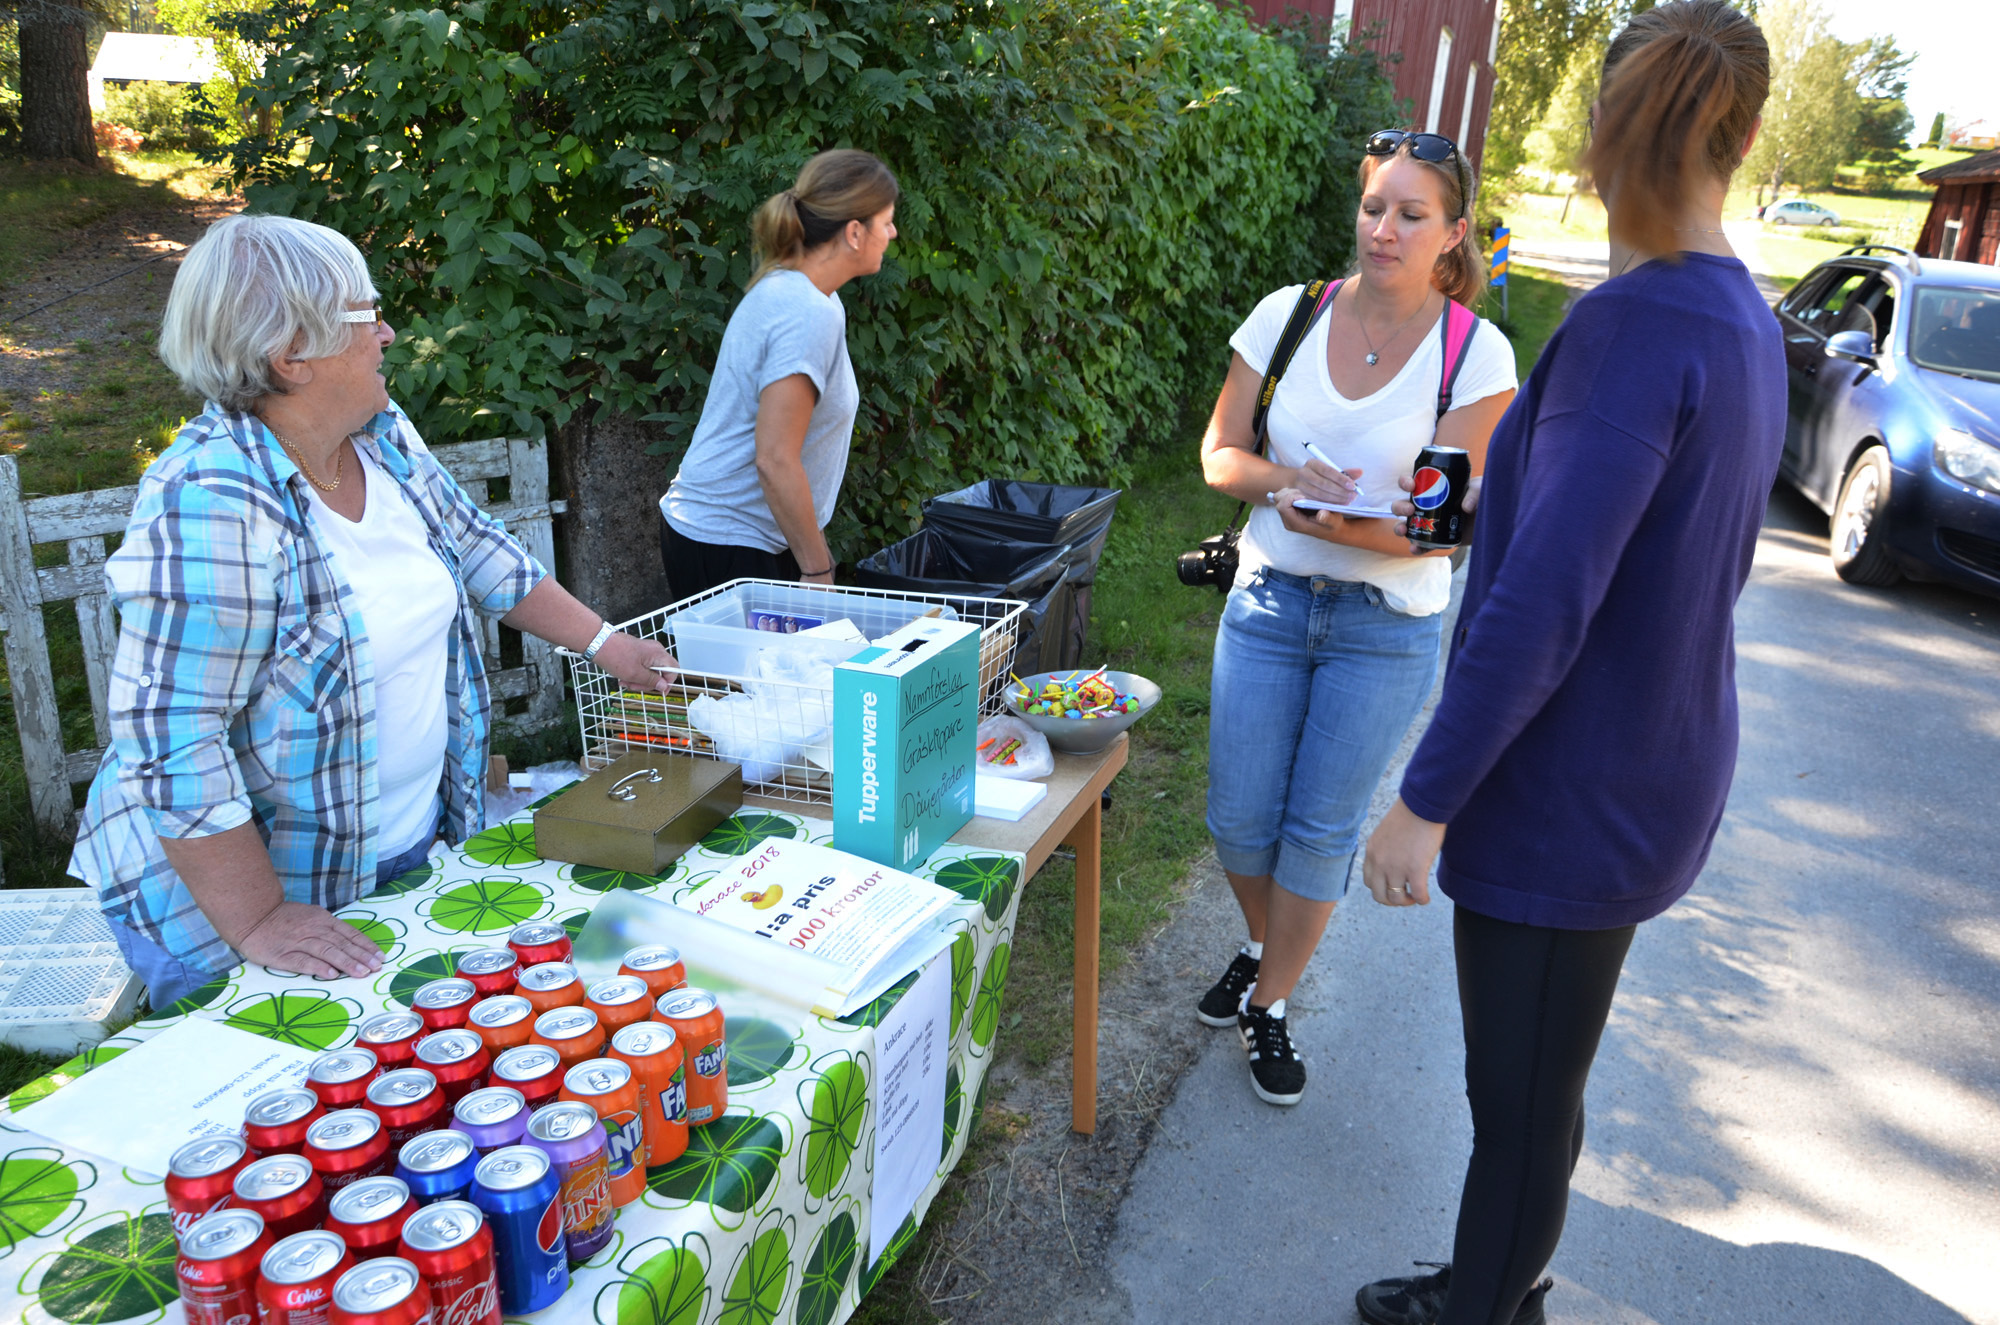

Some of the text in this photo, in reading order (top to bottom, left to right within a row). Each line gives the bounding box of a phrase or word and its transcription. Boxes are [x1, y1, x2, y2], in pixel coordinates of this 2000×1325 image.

[1262, 375, 1278, 406] Nikon
[1410, 516, 1438, 532] MAX
[858, 691, 878, 824] Tupperware
[696, 846, 780, 916] krace 2018
[792, 875, 836, 910] pris
[820, 870, 883, 918] kronor
[883, 1022, 907, 1056] Ankrace
[251, 1053, 281, 1071] Swish
[281, 1060, 304, 1073] Fika
[694, 1041, 727, 1075] FANT
[188, 1119, 213, 1135] 20kr
[880, 1134, 895, 1156] Swish
[178, 1260, 204, 1280] Coke
[428, 1275, 464, 1290] LASSIC
[287, 1288, 326, 1306] Coke
